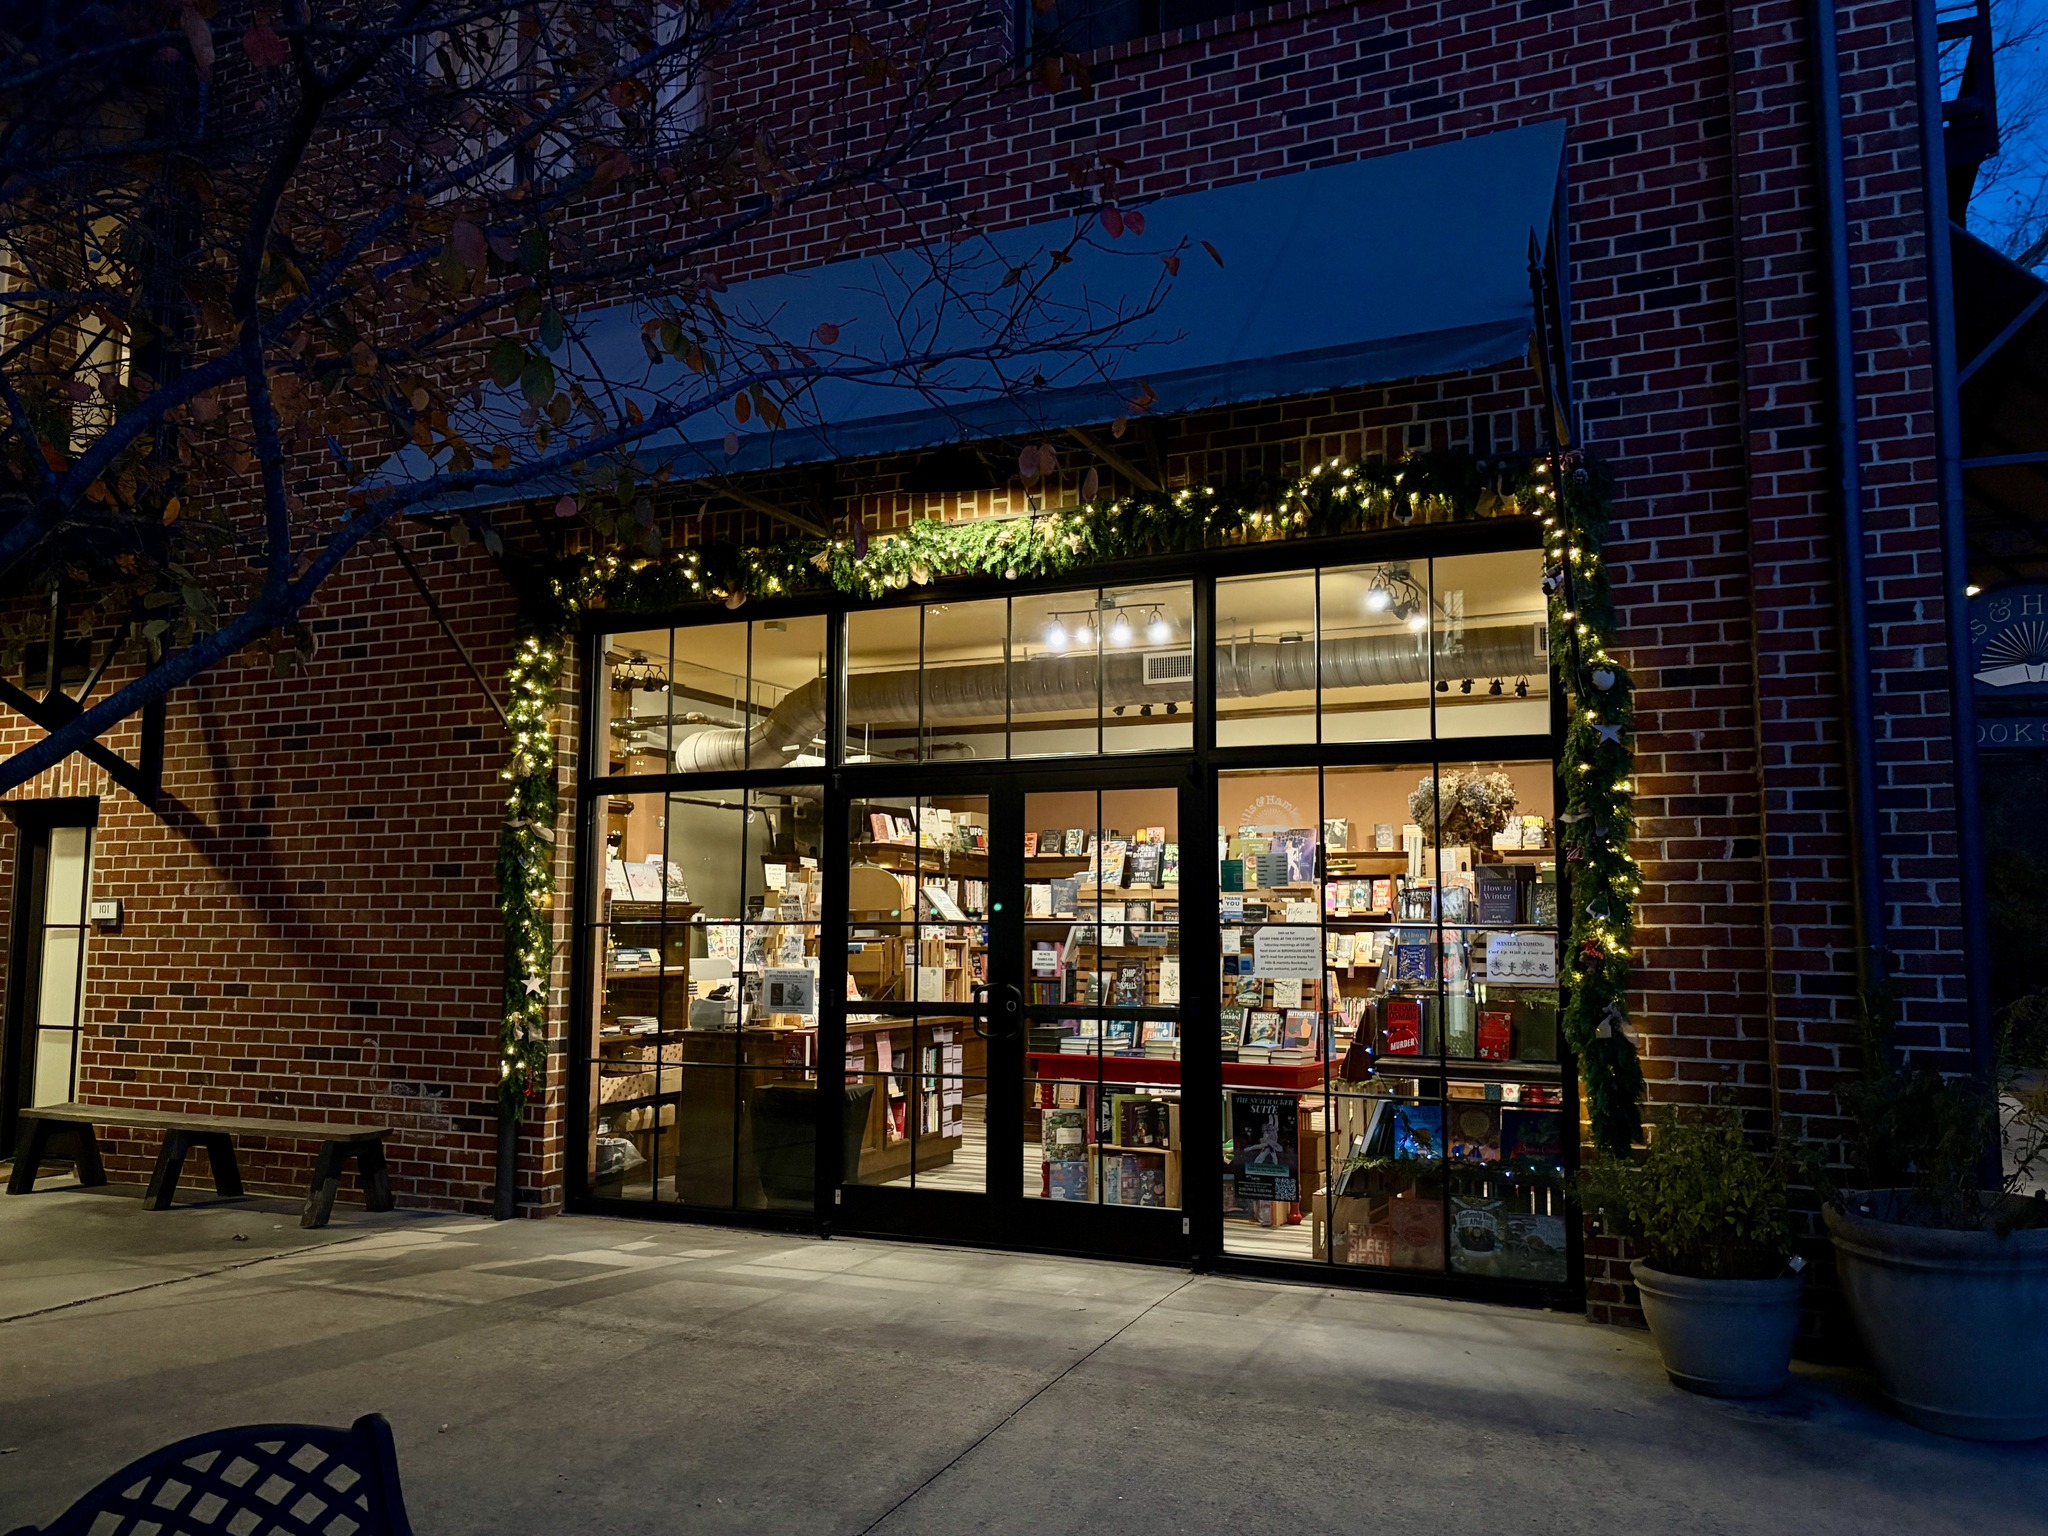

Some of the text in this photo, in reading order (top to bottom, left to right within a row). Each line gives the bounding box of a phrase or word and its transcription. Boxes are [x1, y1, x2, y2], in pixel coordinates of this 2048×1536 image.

[1988, 597, 2012, 623] &
[969, 827, 983, 836] UFO
[1483, 884, 1502, 892] How
[99, 904, 110, 914] 101
[726, 946, 739, 960] U
[1122, 968, 1136, 978] SHIP
[1120, 981, 1137, 990] SPELLS
[1389, 1004, 1417, 1012] RICHARD
[1287, 1010, 1315, 1018] AUTHENTIC
[1390, 1012, 1416, 1020] OSMAN
[1390, 1037, 1415, 1051] MURDER
[1235, 1096, 1294, 1106] THE NUTCRACKER
[1250, 1105, 1279, 1114] SUITE
[1458, 1212, 1483, 1222] Endlessly
[1469, 1218, 1483, 1226] After
[1349, 1224, 1377, 1238] EAT.
